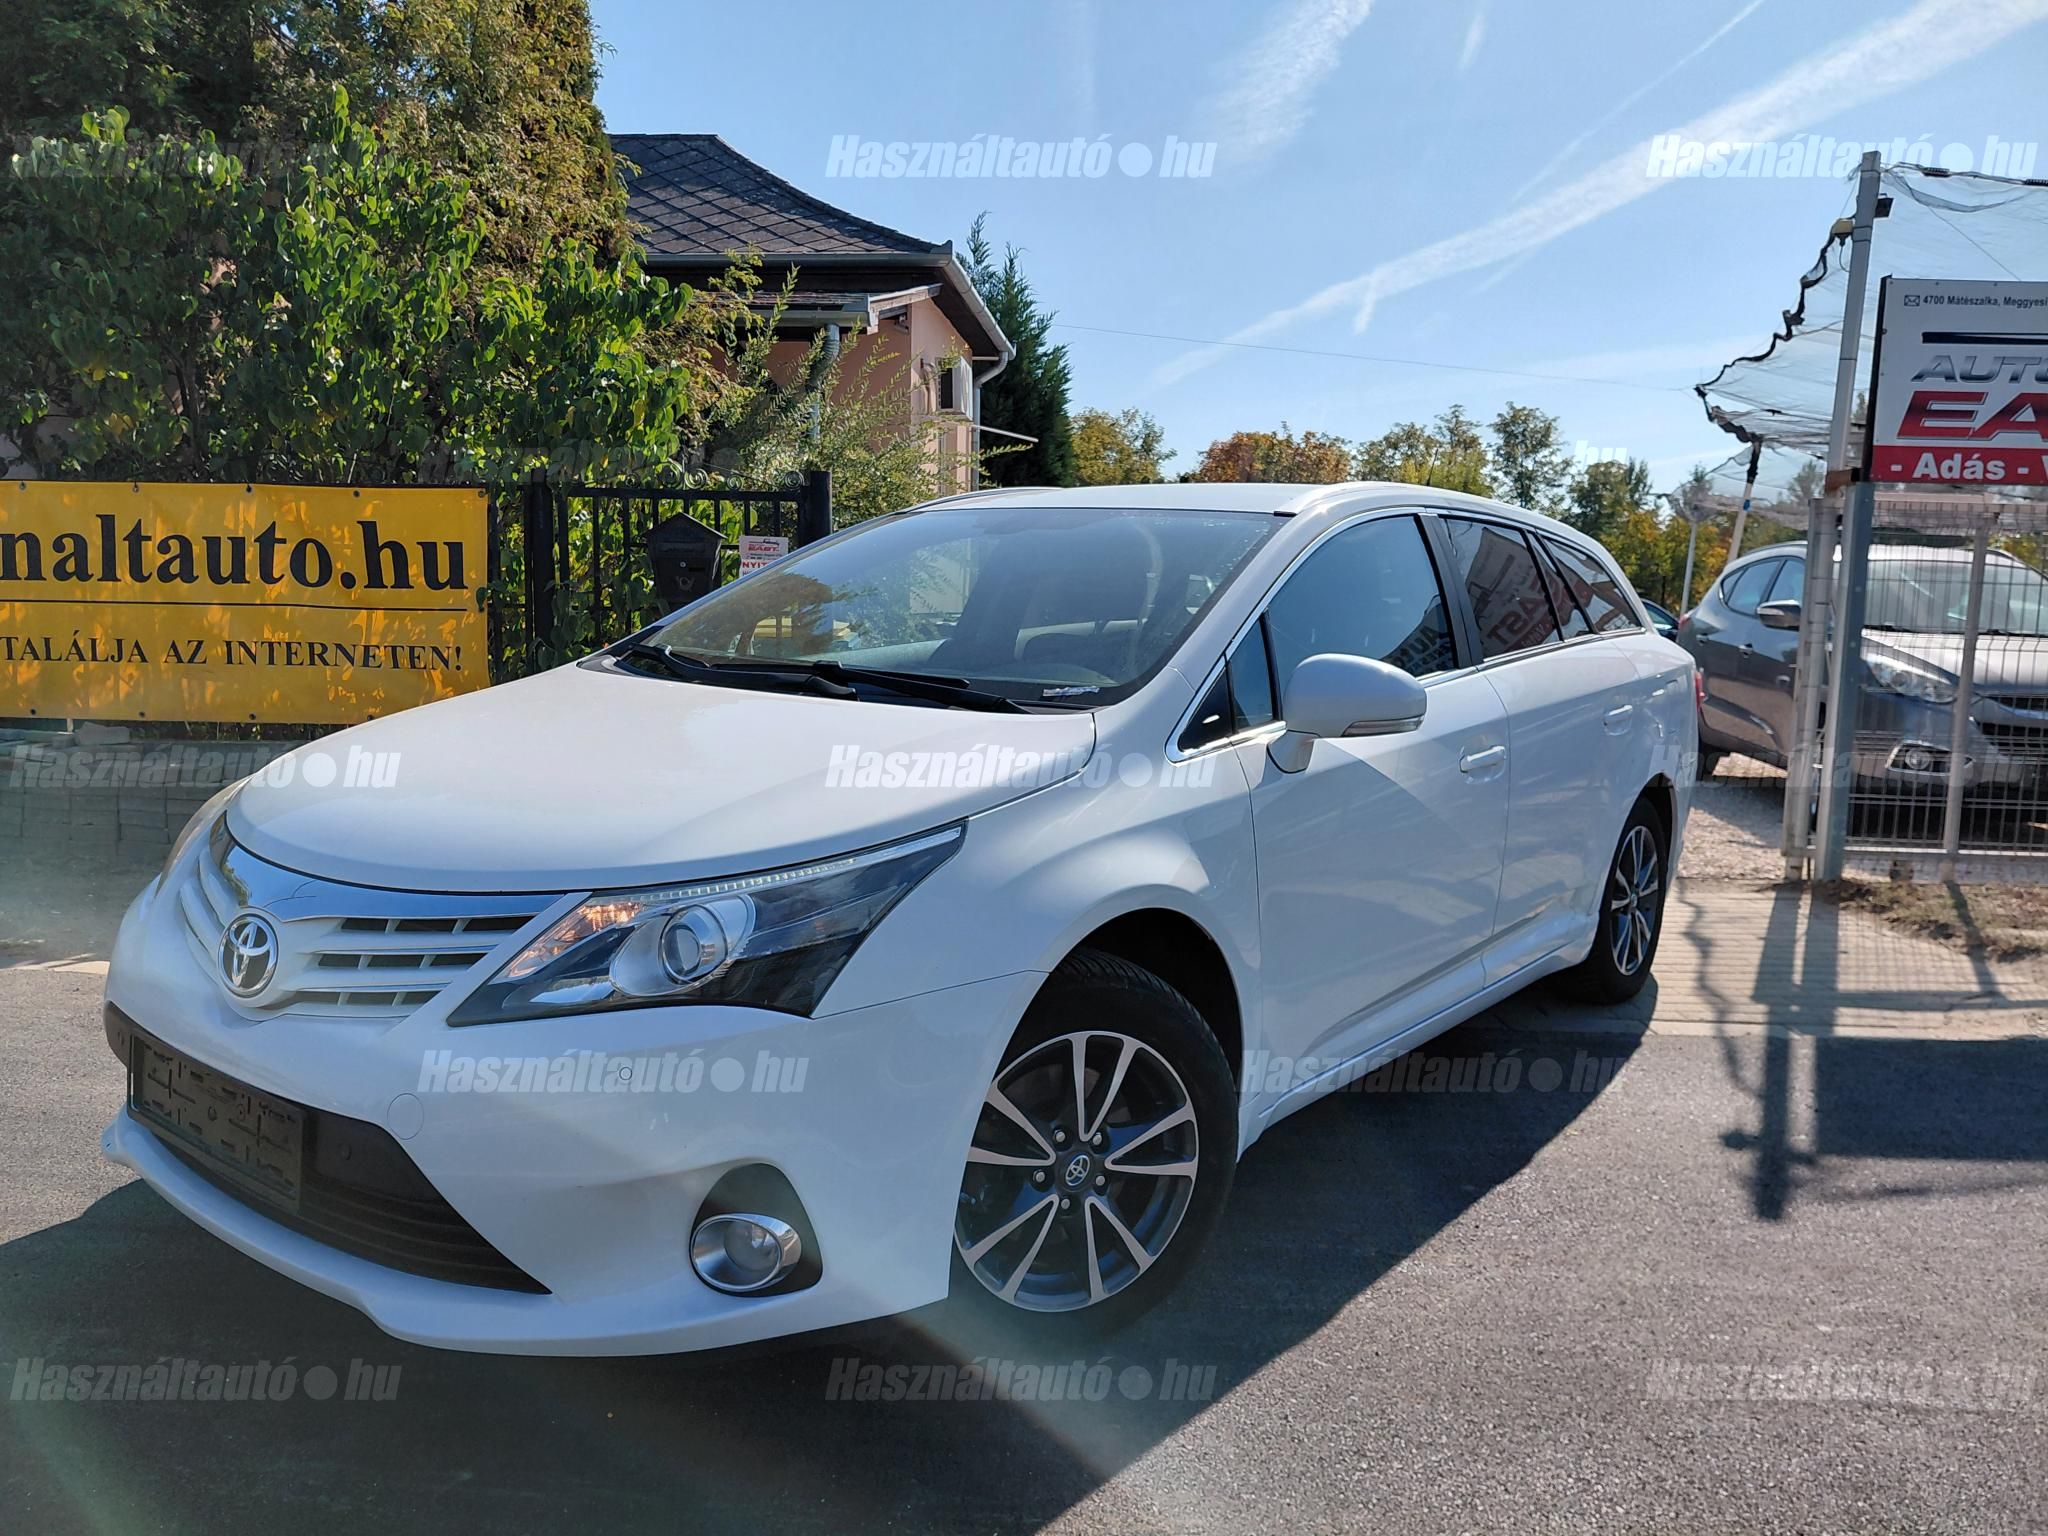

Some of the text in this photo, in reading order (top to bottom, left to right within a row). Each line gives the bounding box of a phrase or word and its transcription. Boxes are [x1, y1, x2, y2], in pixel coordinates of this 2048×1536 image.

[1923, 295, 1945, 305] 4700
[1912, 452, 2006, 481] Adás
[0, 513, 469, 591] naltauto.hu
[1, 630, 464, 672] TALÁLJA AZ INTERNETEN!
